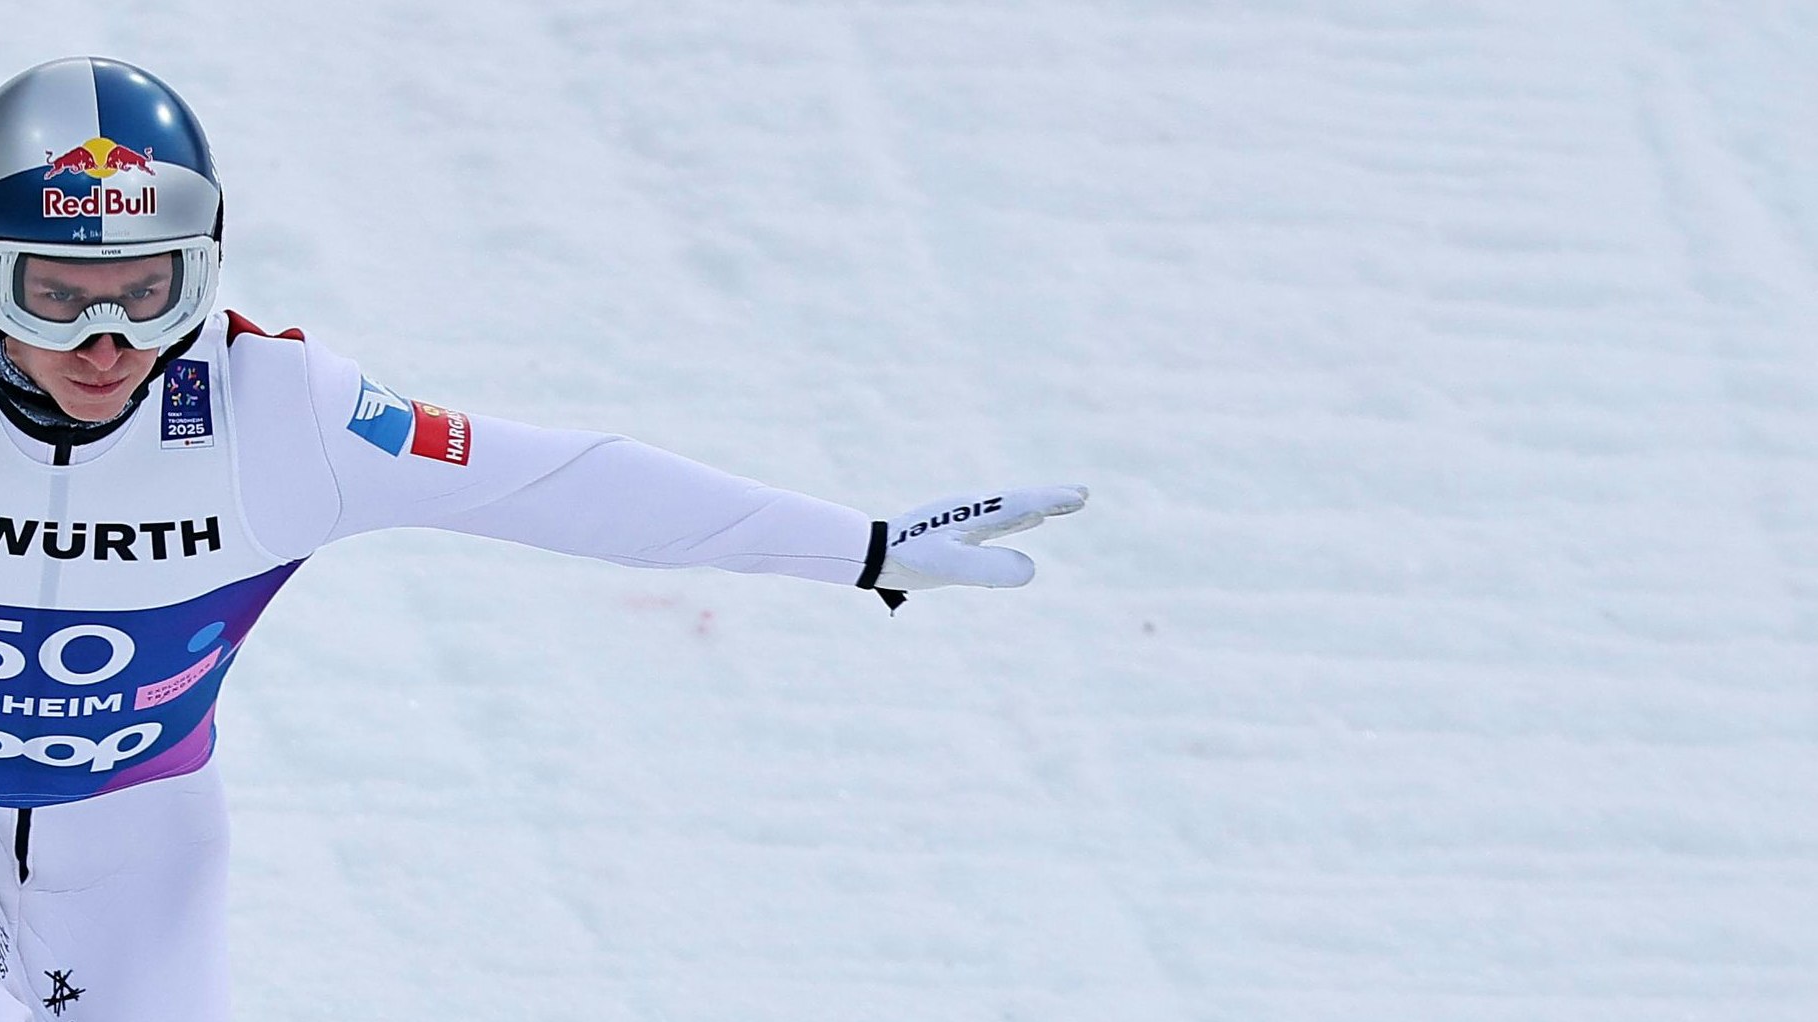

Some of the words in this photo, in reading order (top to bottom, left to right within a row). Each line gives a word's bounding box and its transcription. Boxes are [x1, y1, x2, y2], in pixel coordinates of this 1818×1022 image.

[44, 187, 100, 217] Red
[105, 187, 157, 216] Bull
[168, 424, 205, 435] 2025
[891, 496, 1003, 547] ziener
